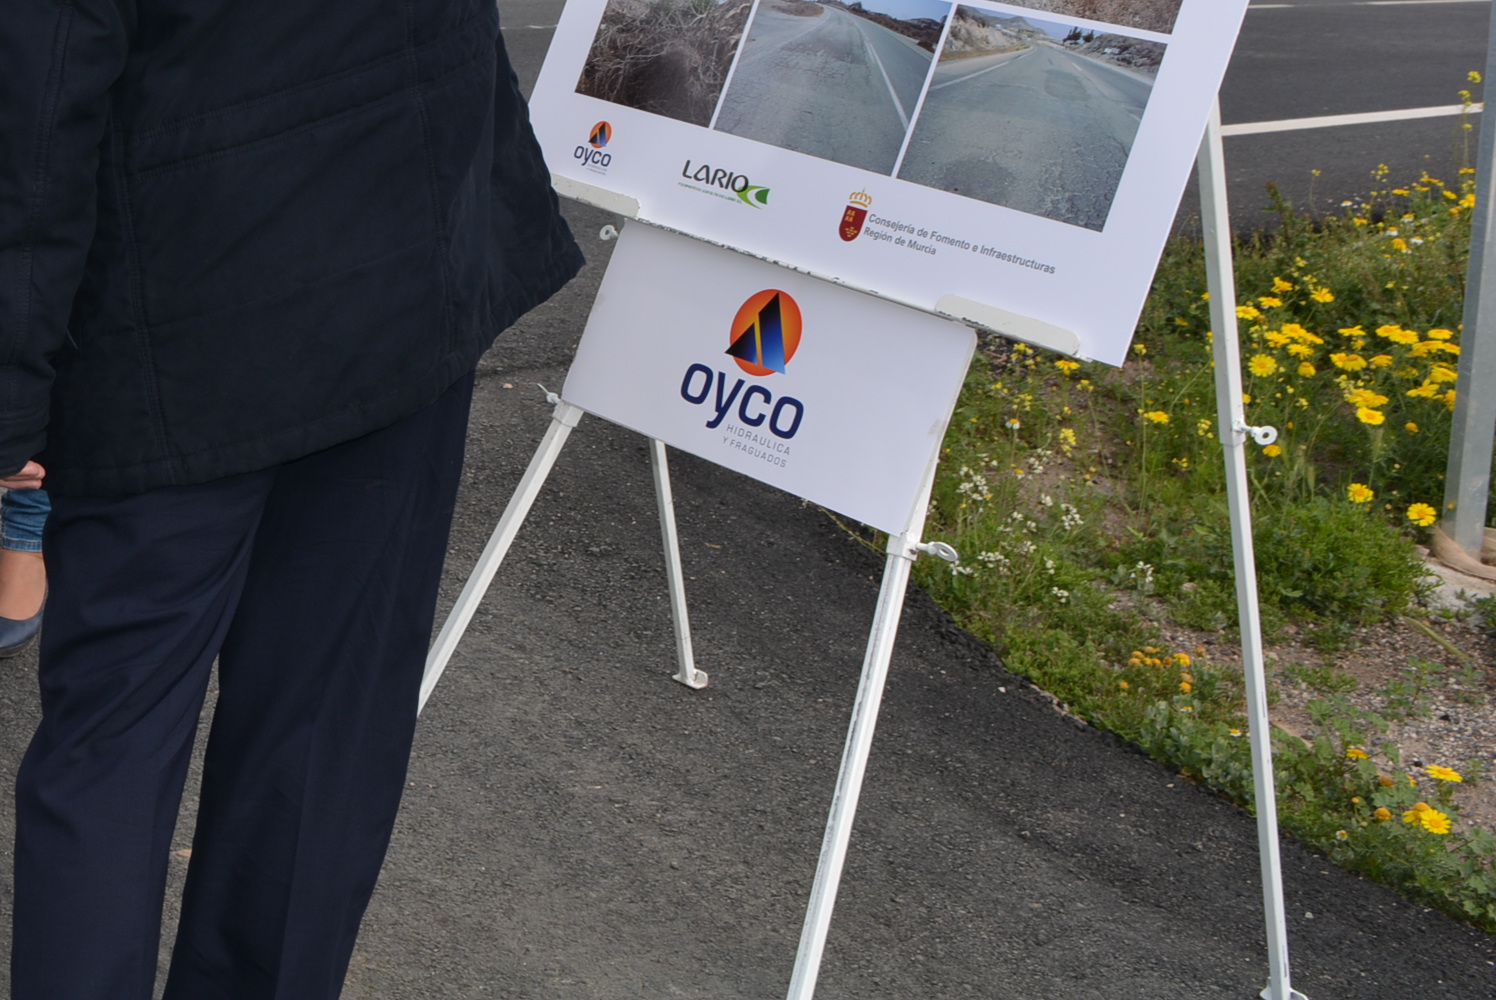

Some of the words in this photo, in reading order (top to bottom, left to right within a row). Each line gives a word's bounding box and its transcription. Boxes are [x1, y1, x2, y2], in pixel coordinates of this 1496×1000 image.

[682, 159, 749, 193] LARIO
[863, 226, 893, 244] Región
[894, 235, 906, 247] de
[907, 239, 937, 255] Murcia
[868, 213, 915, 236] Consejería
[916, 226, 928, 238] de
[929, 230, 970, 251] Fomento
[971, 244, 979, 252] e
[979, 244, 1056, 275] Infraestructuras
[722, 436, 729, 445] Y
[730, 439, 787, 468] FRAGUADOS
[726, 423, 791, 456] HIDRAULICA
